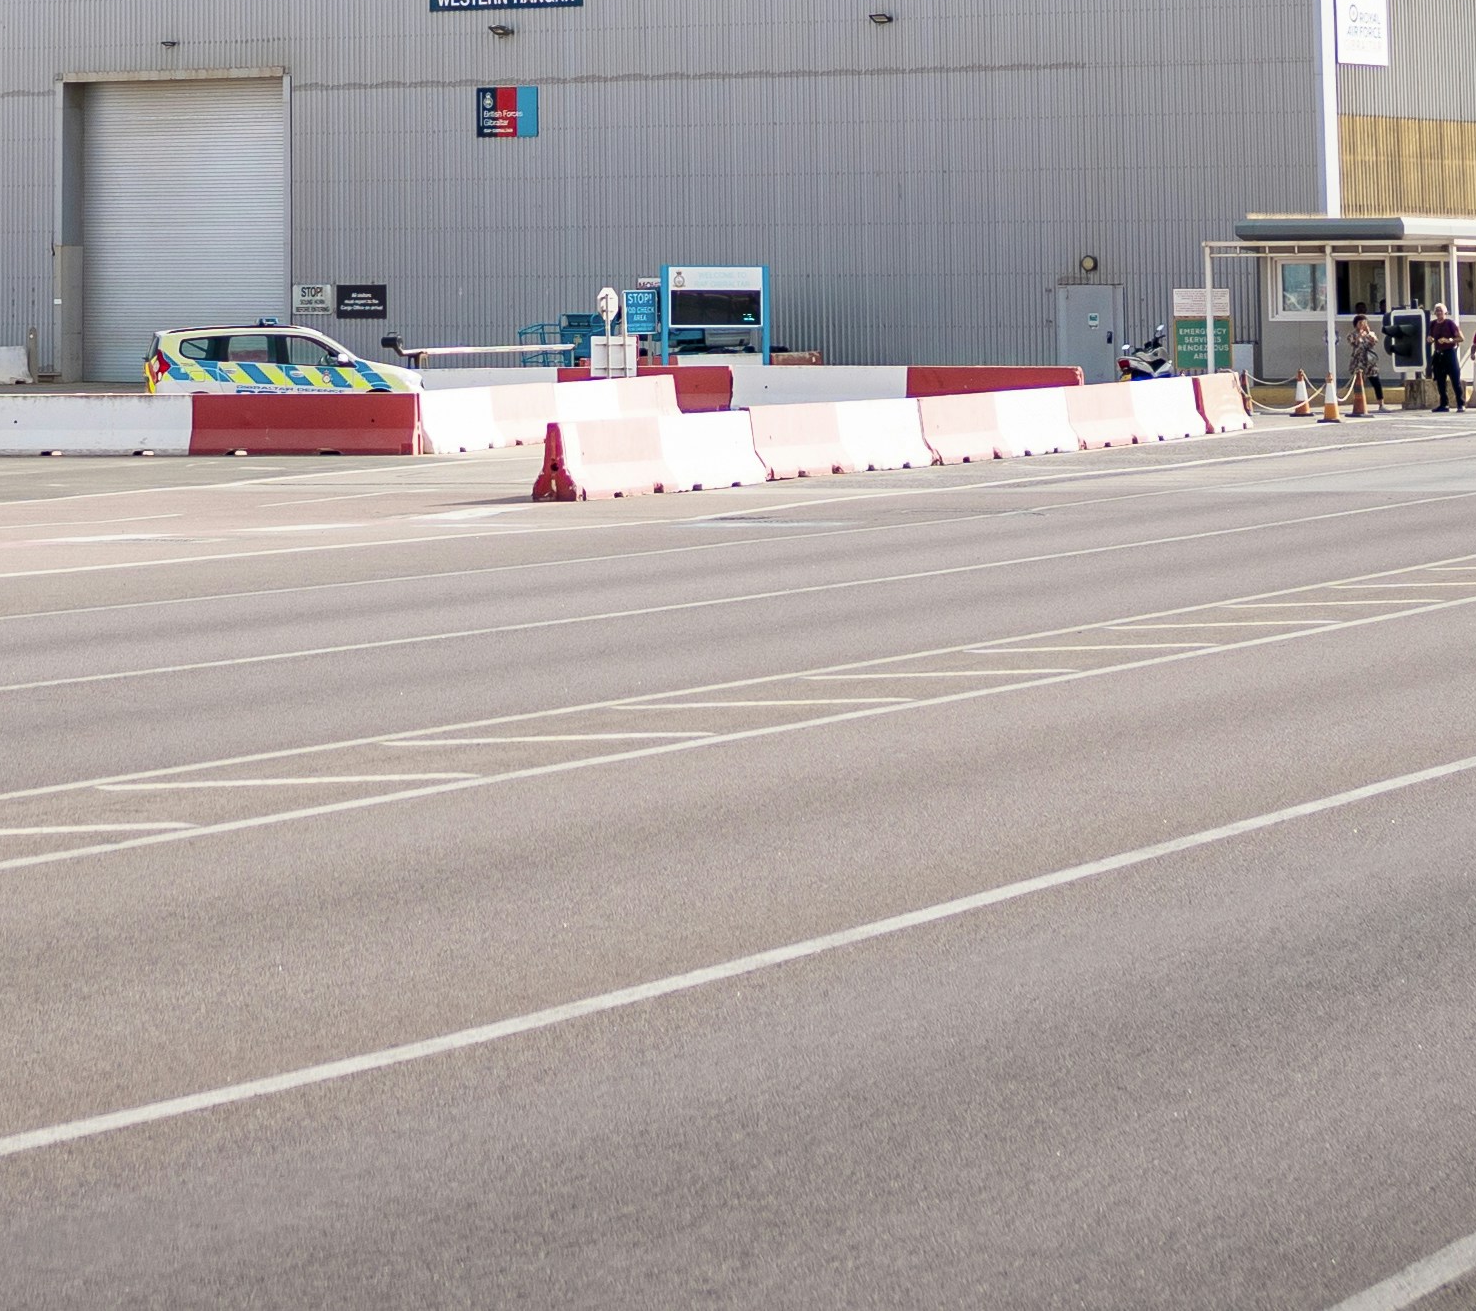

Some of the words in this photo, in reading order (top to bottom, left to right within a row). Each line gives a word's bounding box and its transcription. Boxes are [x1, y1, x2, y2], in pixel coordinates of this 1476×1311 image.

[1360, 26, 1382, 39] FORCE
[483, 110, 502, 118] British
[483, 118, 509, 126] Gibraltar
[301, 287, 323, 297] STOP!
[627, 293, 652, 304] STOP!
[637, 306, 655, 314] CHECK
